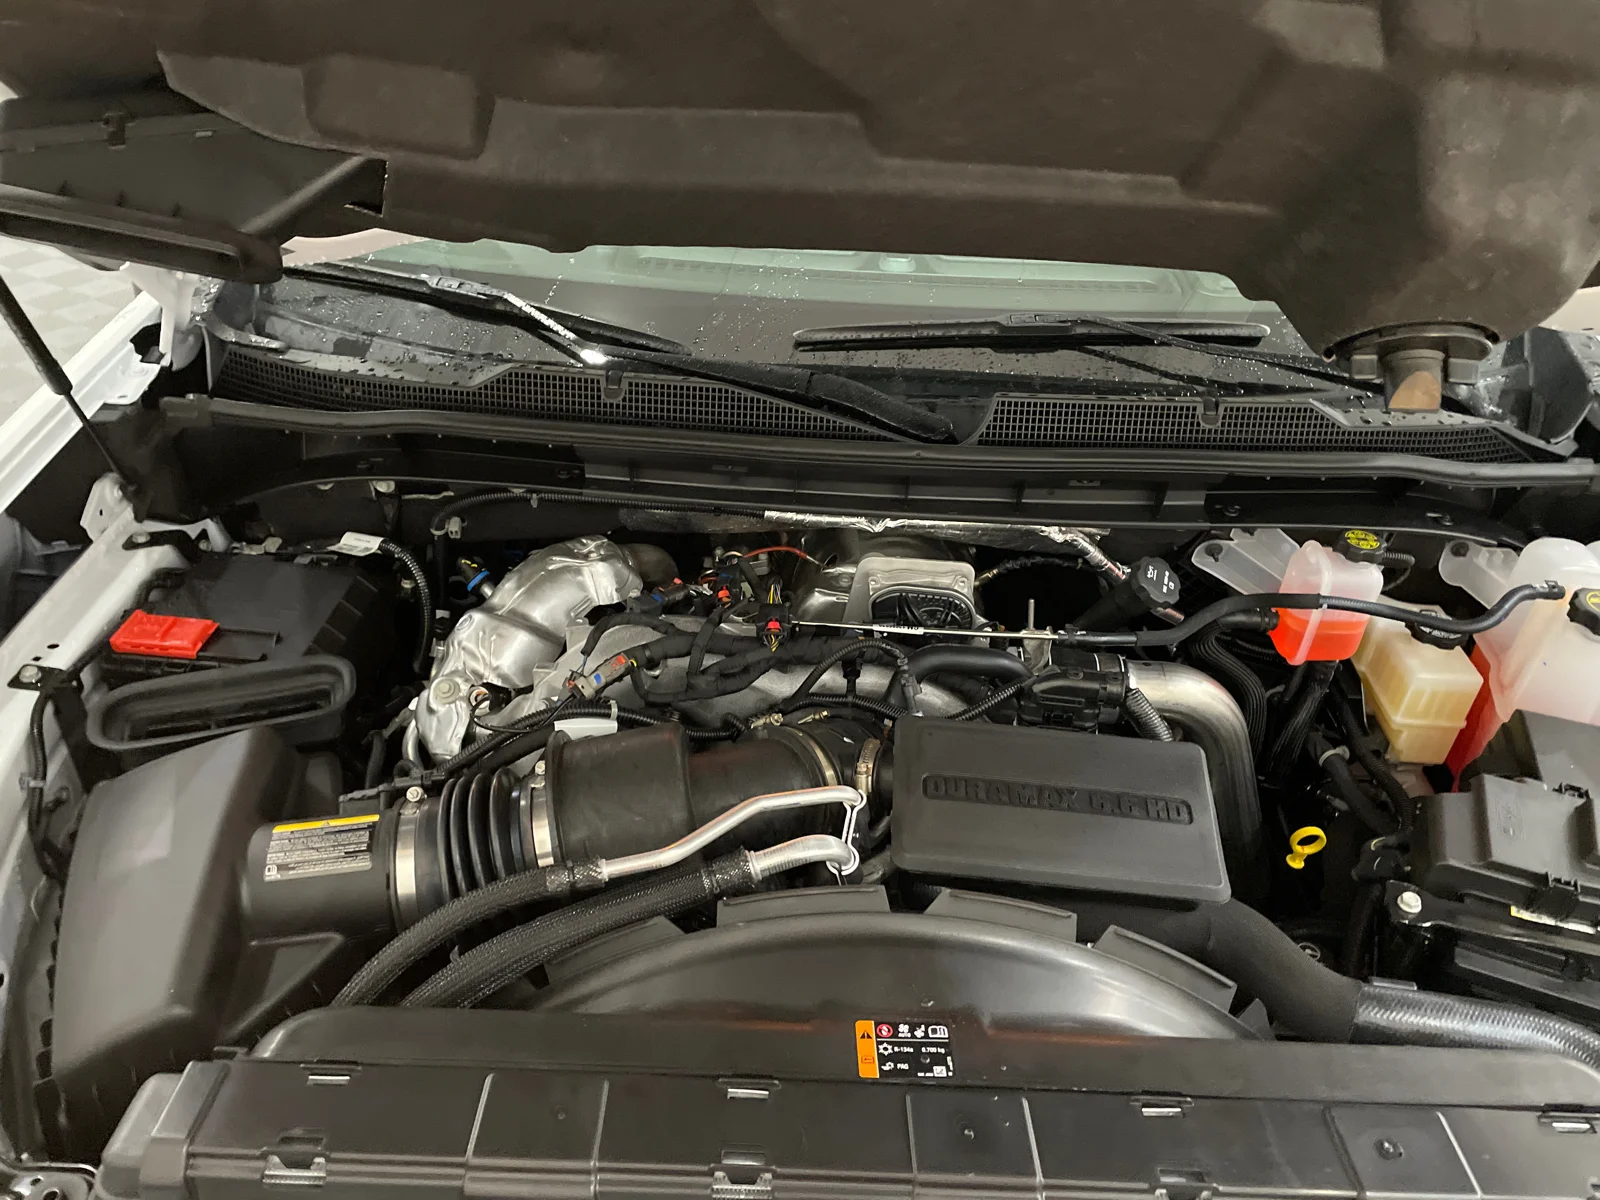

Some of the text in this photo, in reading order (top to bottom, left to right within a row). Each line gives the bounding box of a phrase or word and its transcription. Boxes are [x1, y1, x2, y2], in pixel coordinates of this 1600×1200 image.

[925, 776, 1190, 822] DURAMAX 6.6 HD
